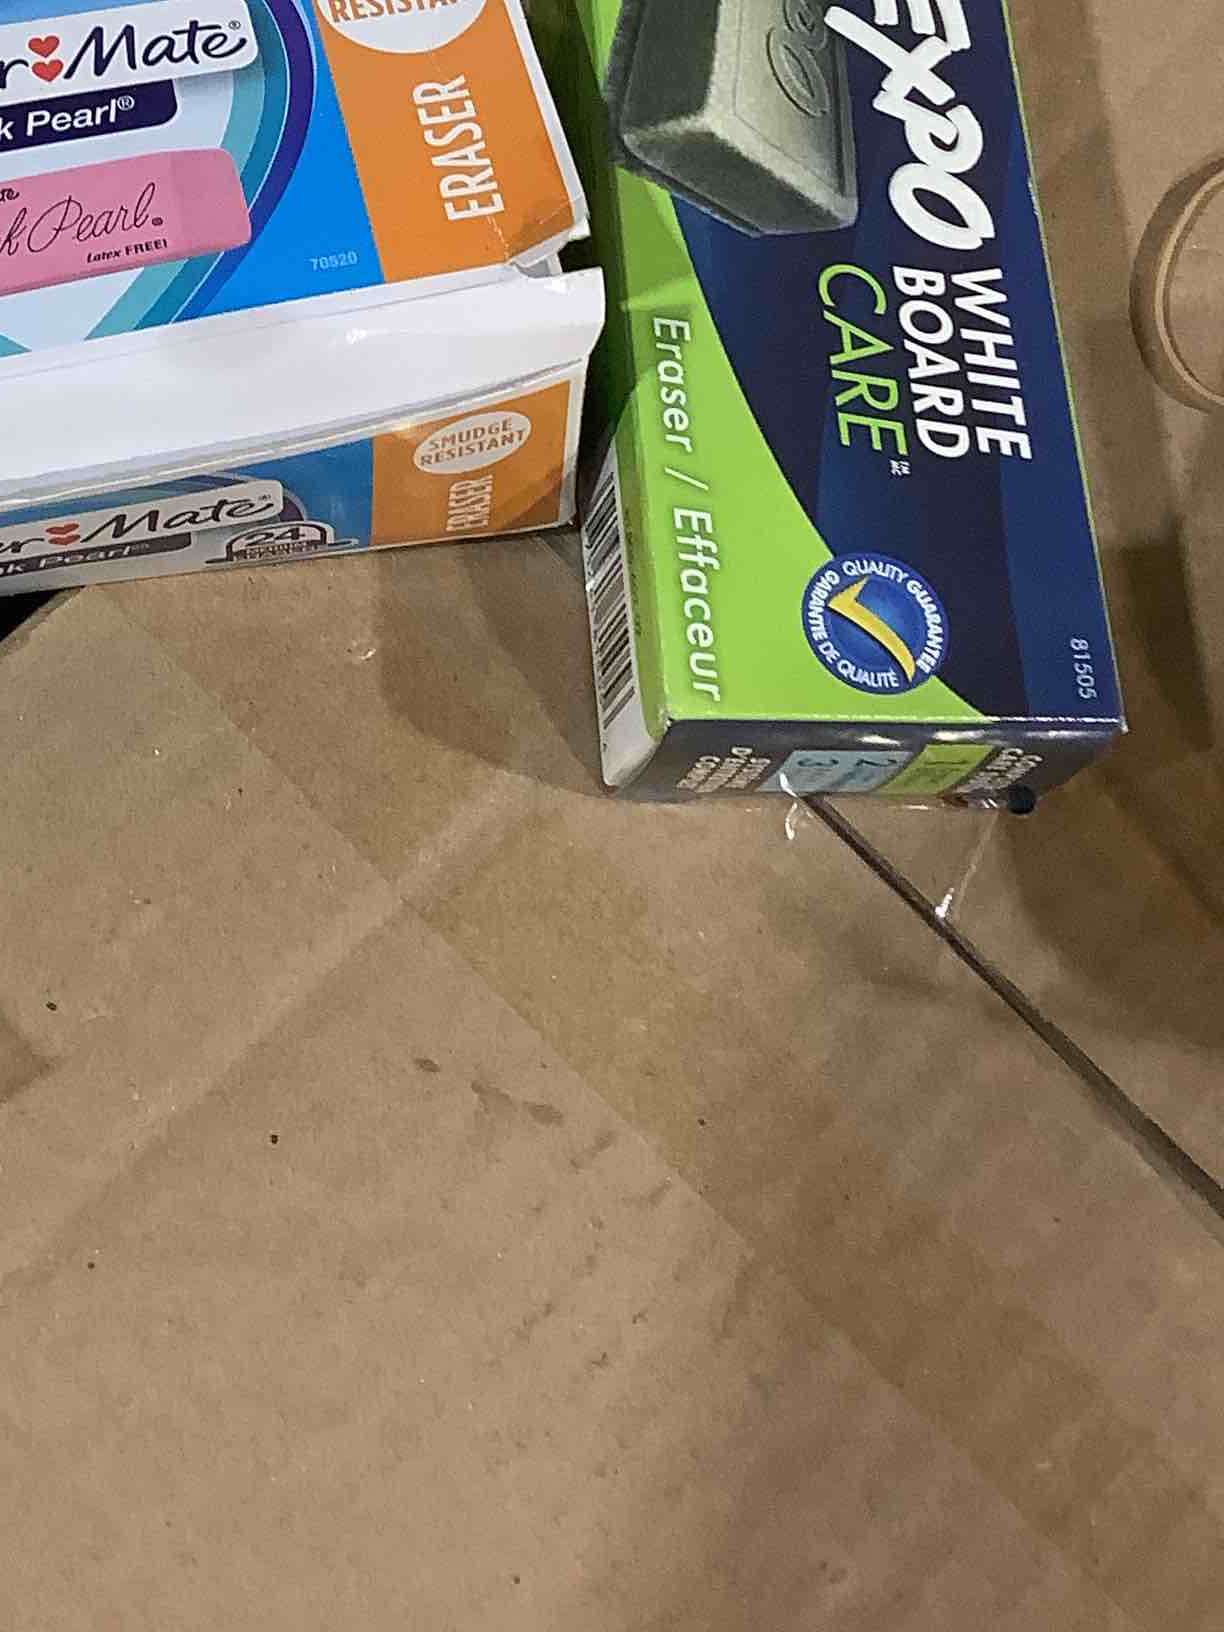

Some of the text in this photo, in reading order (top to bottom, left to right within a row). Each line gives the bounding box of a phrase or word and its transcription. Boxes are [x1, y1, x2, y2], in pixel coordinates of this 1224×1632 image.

[411, 72, 506, 222] ERASER
[85, 237, 169, 265] Latex FREE!
[308, 250, 359, 271] 70520
[817, 263, 910, 457] CARE
[891, 264, 971, 459] BOARD
[950, 267, 1033, 461] WHITE
[419, 428, 525, 467] RESISTANT
[428, 416, 513, 452] SMUDGE
[245, 525, 307, 546] 24
[446, 473, 494, 533] ERASER
[653, 316, 721, 703] Eraser / Effaceur
[807, 569, 900, 689] GARANTIE DE QUALITÉ
[841, 559, 944, 674] QUALITY GUARANTEE
[1069, 637, 1097, 699] 81505
